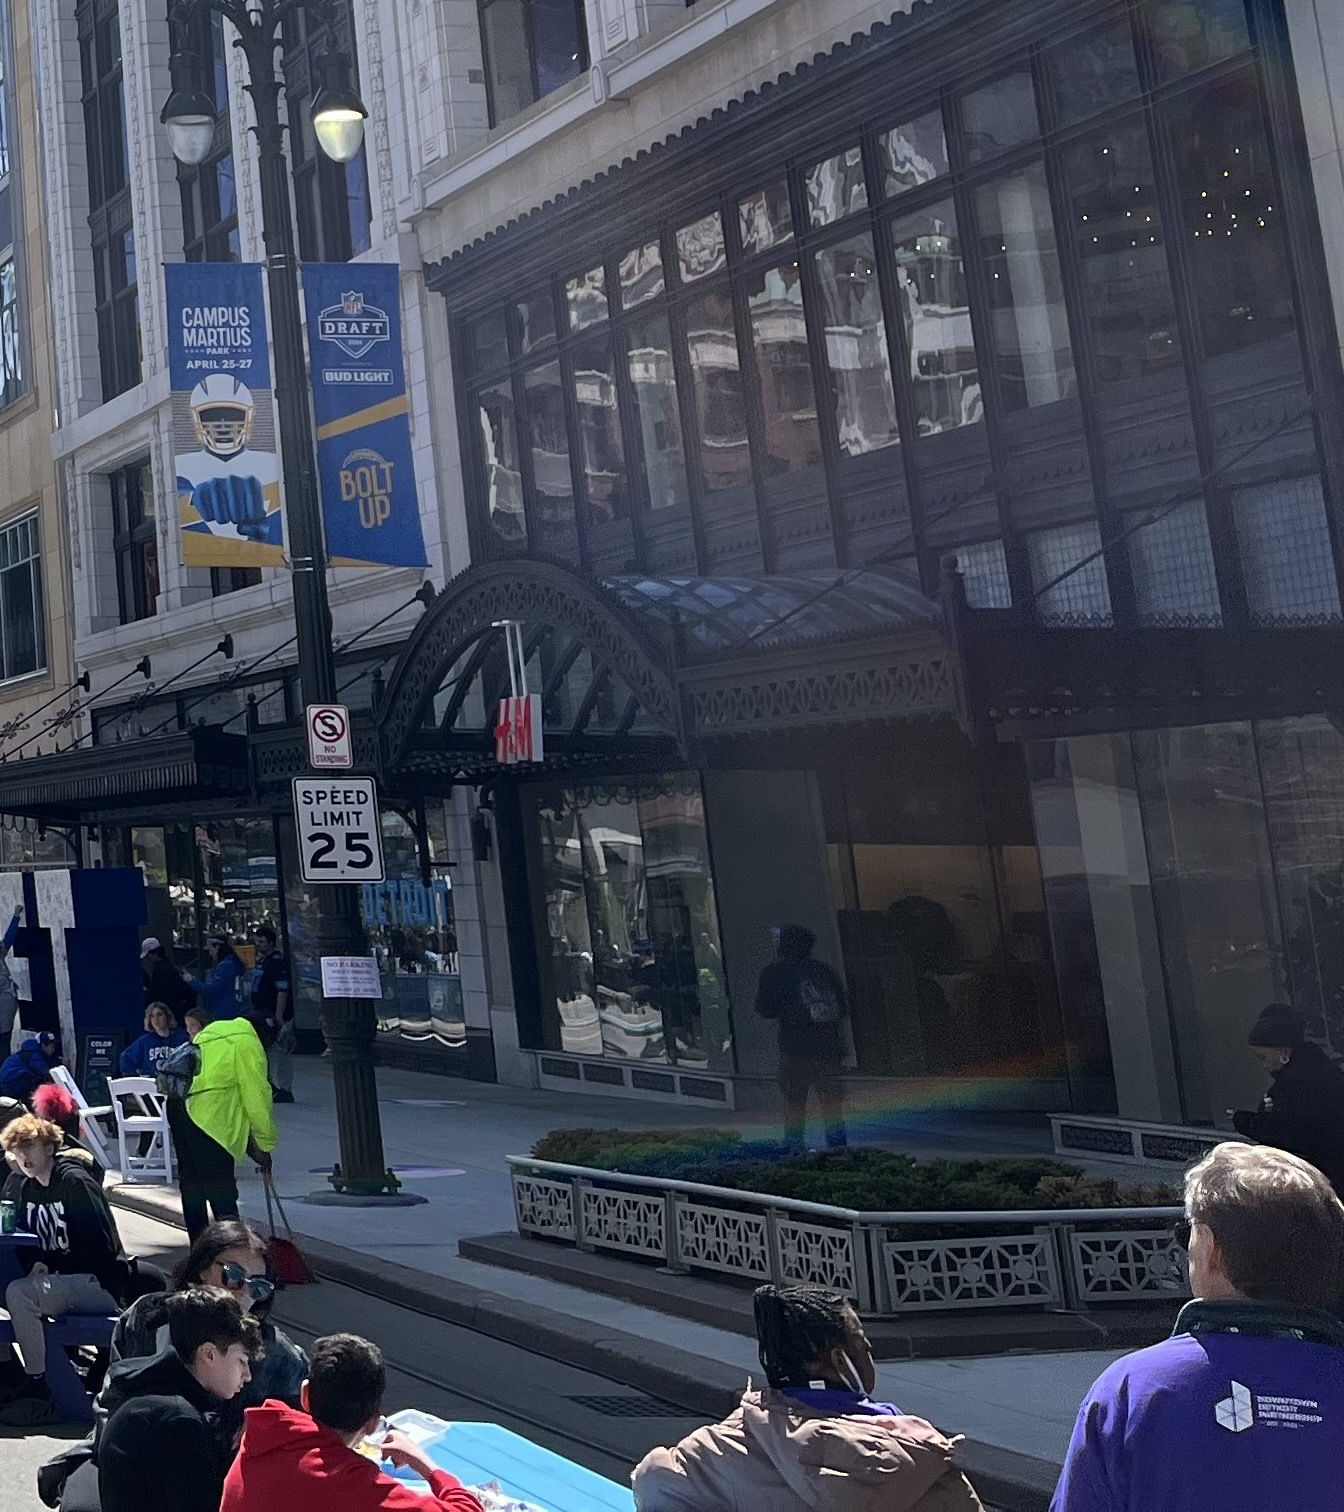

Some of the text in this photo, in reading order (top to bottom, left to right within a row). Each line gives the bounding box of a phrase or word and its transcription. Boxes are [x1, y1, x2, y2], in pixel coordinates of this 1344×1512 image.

[343, 301, 362, 314] NFL
[182, 306, 251, 328] CAMPUS
[324, 321, 384, 335] DRAFT
[183, 327, 252, 347] MARTIUS
[206, 347, 230, 355] PARK
[186, 359, 253, 370] APRIL 25-27
[324, 371, 391, 383] BUD LIGHT
[339, 462, 394, 502] BOLT
[357, 496, 391, 529] UP
[324, 745, 337, 754] NO
[315, 754, 348, 764] STANDING
[302, 790, 369, 805] SPEED
[311, 811, 363, 827] LIMIT
[307, 832, 374, 869] 25
[358, 879, 449, 926] DETROIT
[1256, 1395, 1318, 1408] DOWNTOWN
[1258, 1403, 1299, 1413] DETROIT
[1258, 1411, 1324, 1423] PARTNERSHIP
